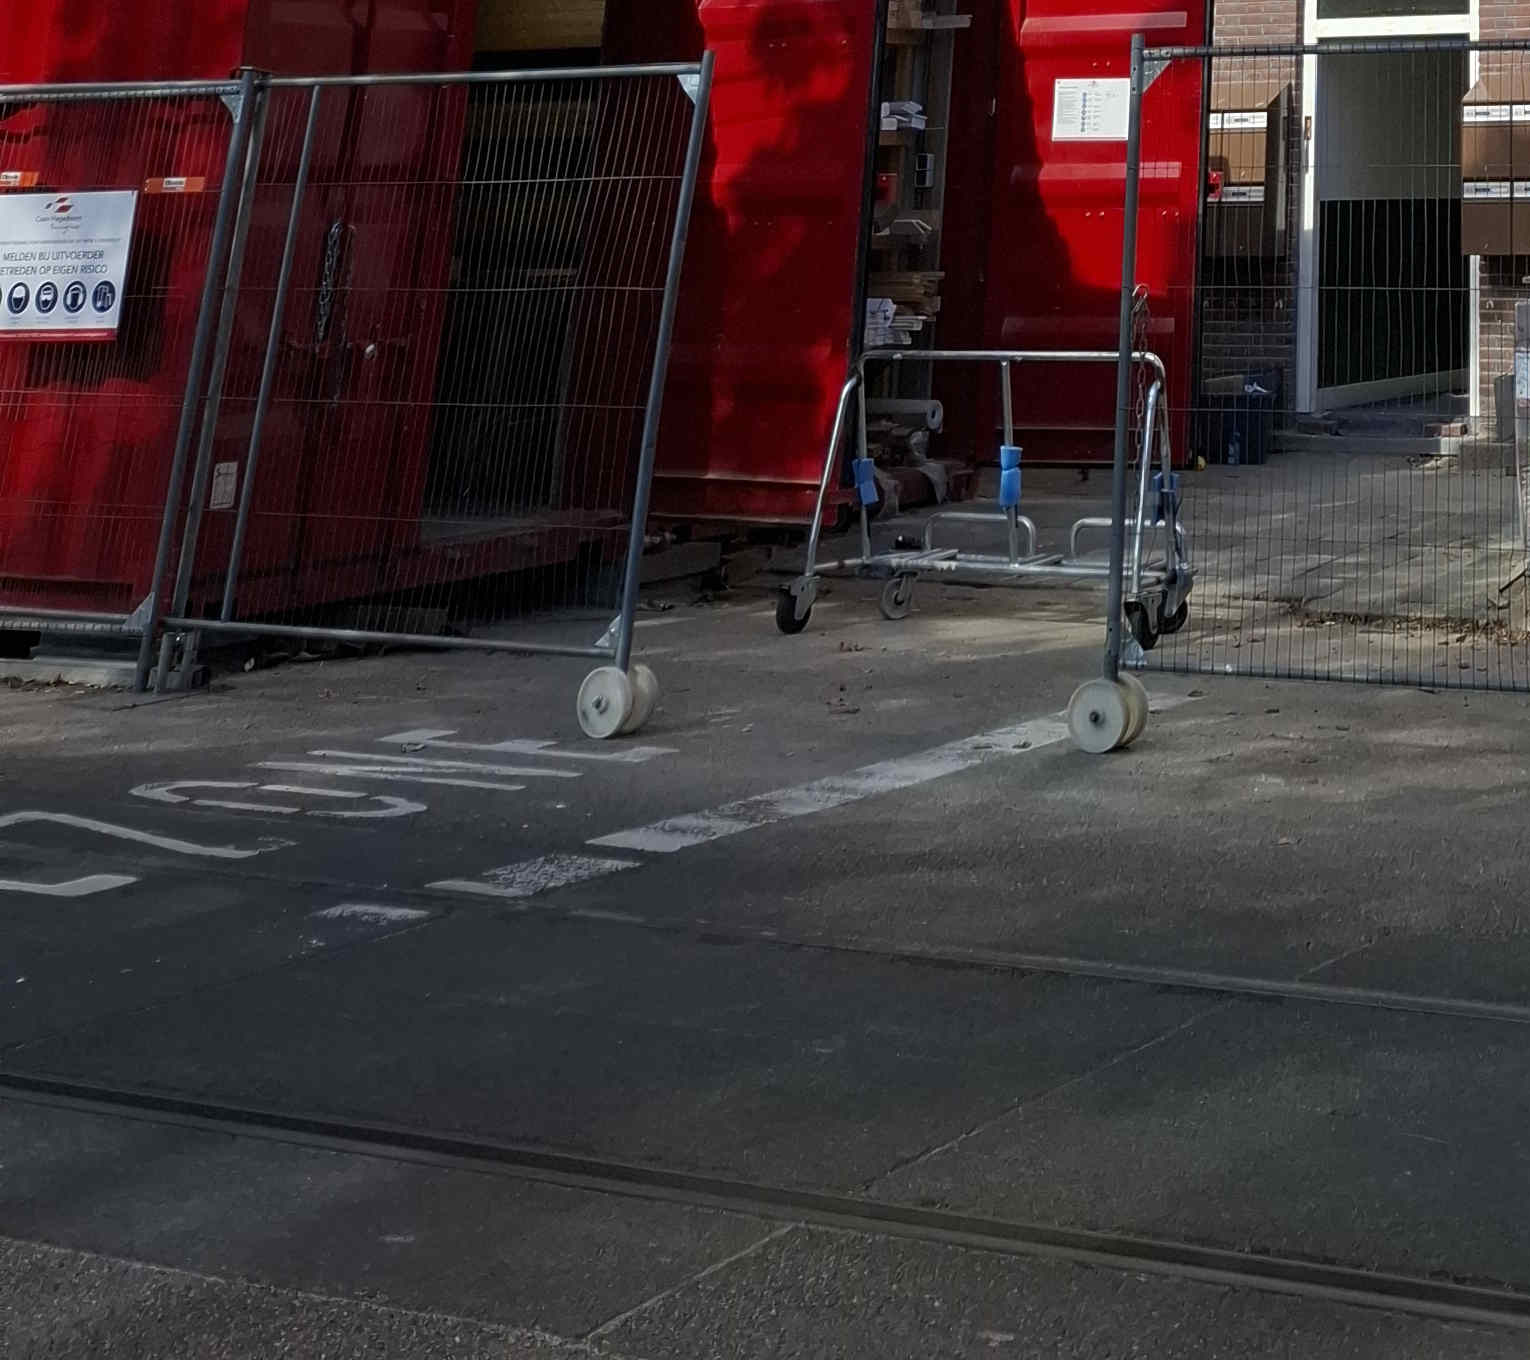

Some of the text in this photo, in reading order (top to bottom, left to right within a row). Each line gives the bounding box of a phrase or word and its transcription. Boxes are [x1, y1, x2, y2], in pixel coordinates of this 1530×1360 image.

[0, 266, 36, 276] ETREDEN
[39, 265, 52, 275] OP
[80, 264, 108, 274] RISICO
